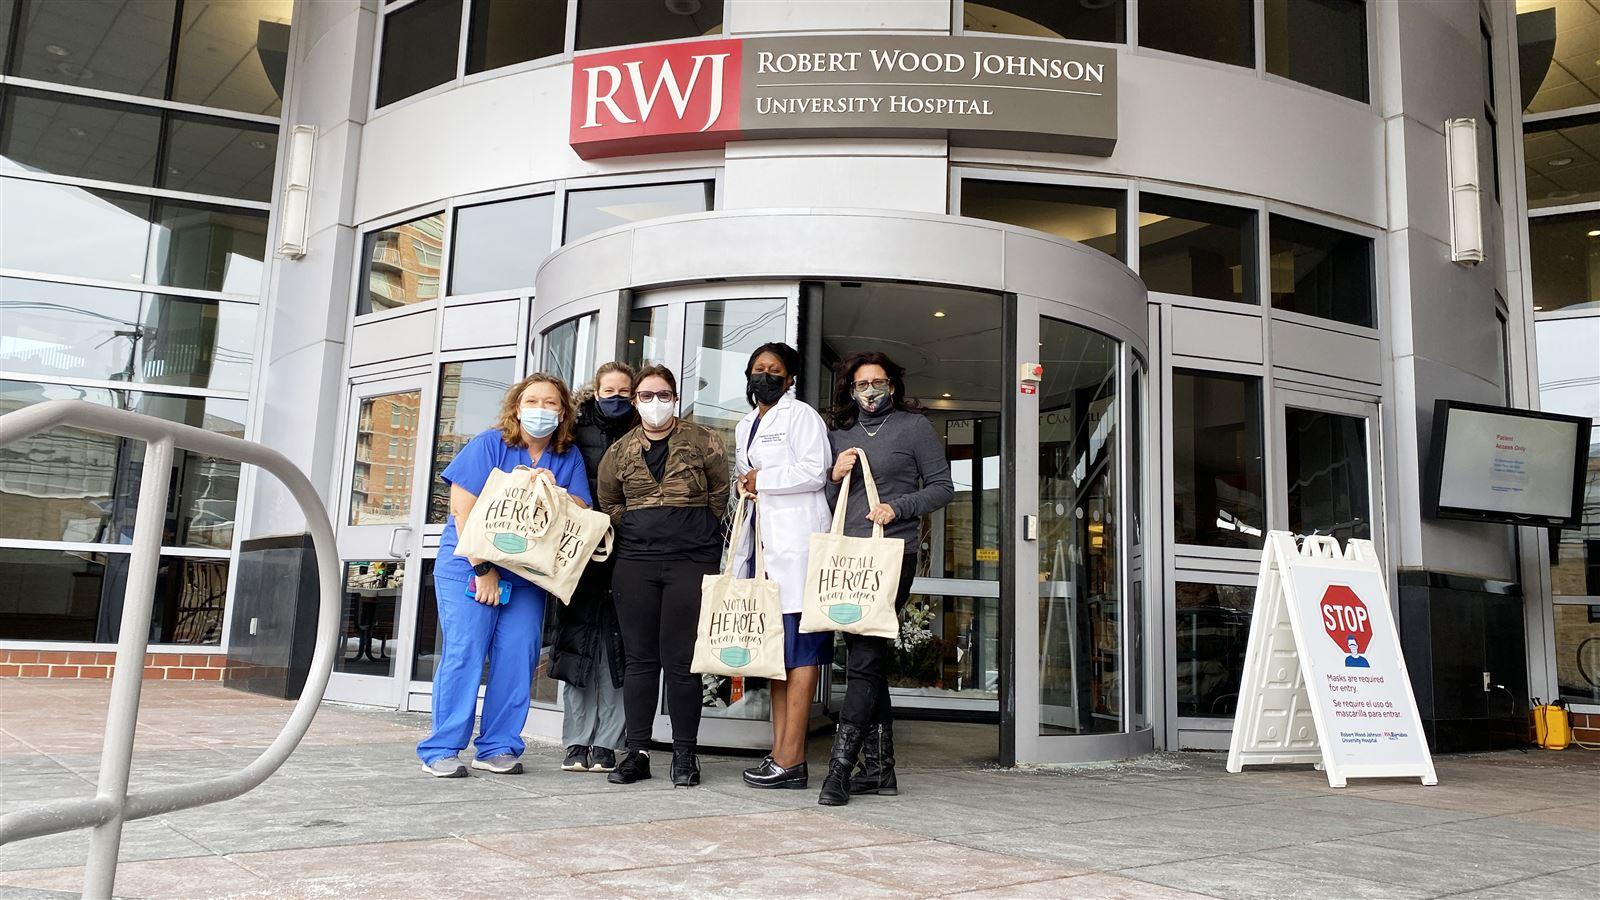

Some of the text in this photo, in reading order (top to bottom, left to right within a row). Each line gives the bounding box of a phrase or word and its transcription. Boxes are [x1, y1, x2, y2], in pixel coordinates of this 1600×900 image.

[757, 50, 1105, 83] ROBERT WOOD JOHNSON
[580, 53, 730, 132] RWJ
[756, 95, 993, 115] UNIVERSITY HOSPITAL
[830, 555, 876, 569] NOT ALL
[818, 568, 883, 594] HEROES
[820, 591, 875, 604] wear capes
[709, 612, 766, 637] HEROES
[1323, 604, 1367, 632] STOP
[711, 635, 762, 648] wear capes
[1327, 674, 1346, 682] Masks
[1359, 675, 1384, 684] required
[1329, 683, 1358, 693] for entry.
[1333, 699, 1341, 707] Se
[1343, 700, 1365, 709] require
